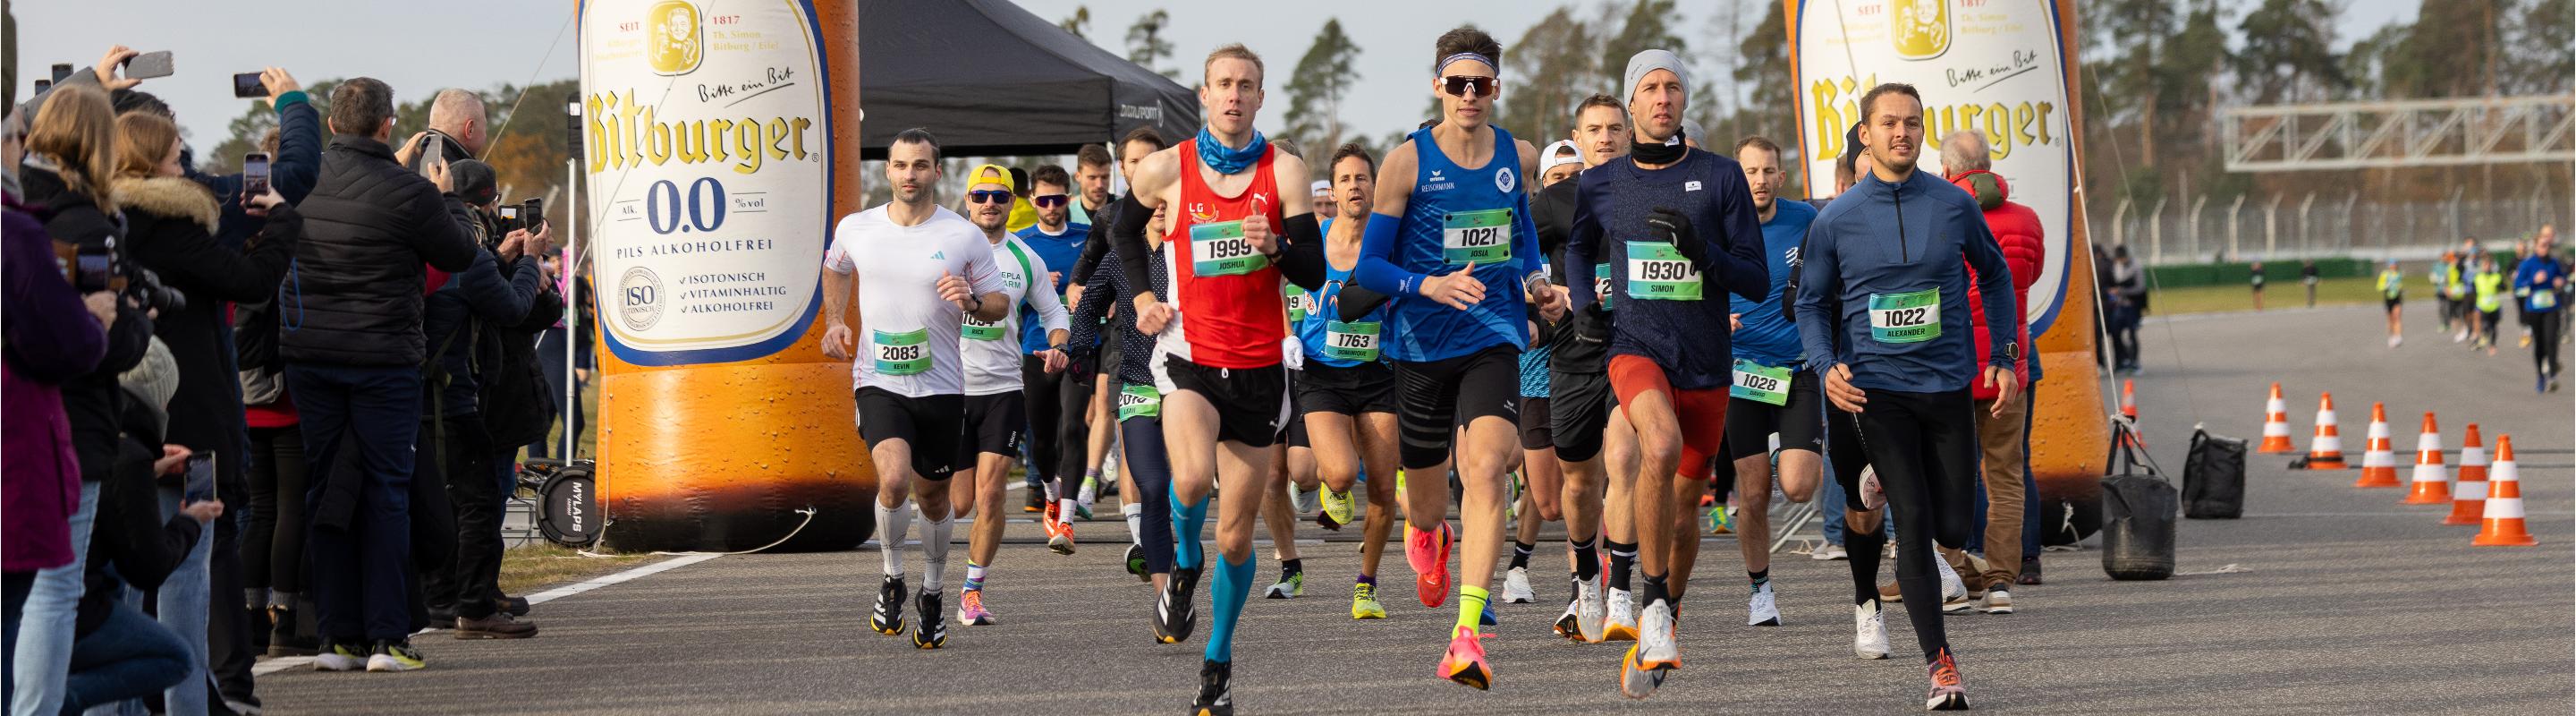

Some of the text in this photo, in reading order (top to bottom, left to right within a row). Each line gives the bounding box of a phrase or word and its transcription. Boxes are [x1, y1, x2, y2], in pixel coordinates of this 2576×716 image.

[1857, 4, 1882, 15] SEIT
[619, 21, 640, 32] SEIT
[713, 15, 741, 25] 1817
[1946, 50, 2038, 88] Bitte ein Bit
[698, 67, 794, 103] Bitte ein Bit
[586, 88, 811, 174] Bitburger
[1421, 182, 1455, 192] REISCHMANN
[622, 206, 638, 215] Alk.
[647, 176, 726, 235] 0.0
[1462, 227, 1498, 247] 1021
[617, 239, 773, 260] PILS ALKOHOLFREI
[1208, 238, 1252, 259] 1999
[1470, 250, 1488, 258] JOSIA
[1218, 260, 1245, 270] JOSHUA
[1641, 261, 1686, 280] 1930
[689, 272, 766, 285] ISOTONISCH
[626, 285, 655, 306] ISO
[690, 286, 787, 299] VITAMINHALTIG
[1650, 285, 1674, 293] SIMON
[691, 301, 774, 313] ALKOHOLFREI
[1885, 308, 1926, 327] 1022
[1887, 328, 1926, 337] ALEXANDER
[1338, 334, 1370, 348] 1763
[882, 345, 919, 360] 2083
[1337, 349, 1368, 357] DOMINIQUE
[1742, 373, 1777, 392] 1028
[572, 482, 582, 533] MYLAPS
